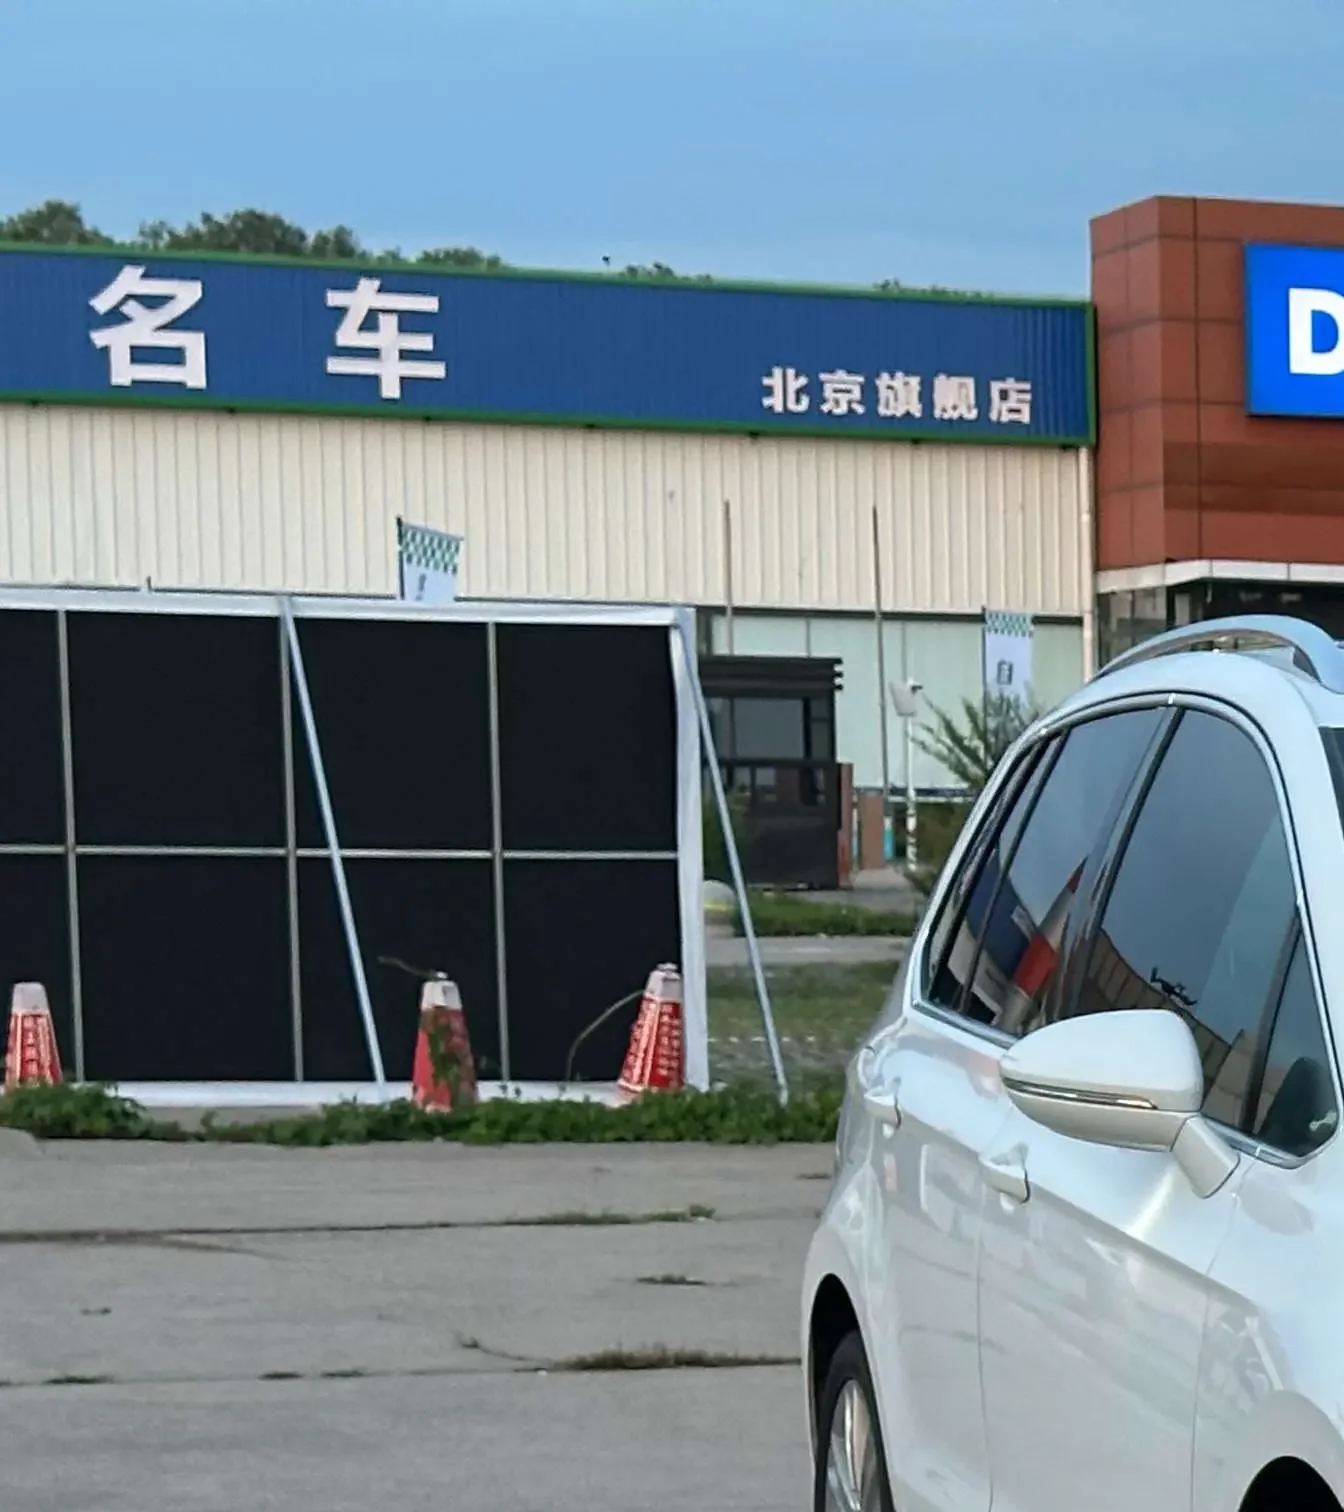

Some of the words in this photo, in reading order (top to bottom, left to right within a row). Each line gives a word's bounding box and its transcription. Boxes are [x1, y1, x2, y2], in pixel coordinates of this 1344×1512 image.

[761, 366, 1032, 424] 北京旗舰店
